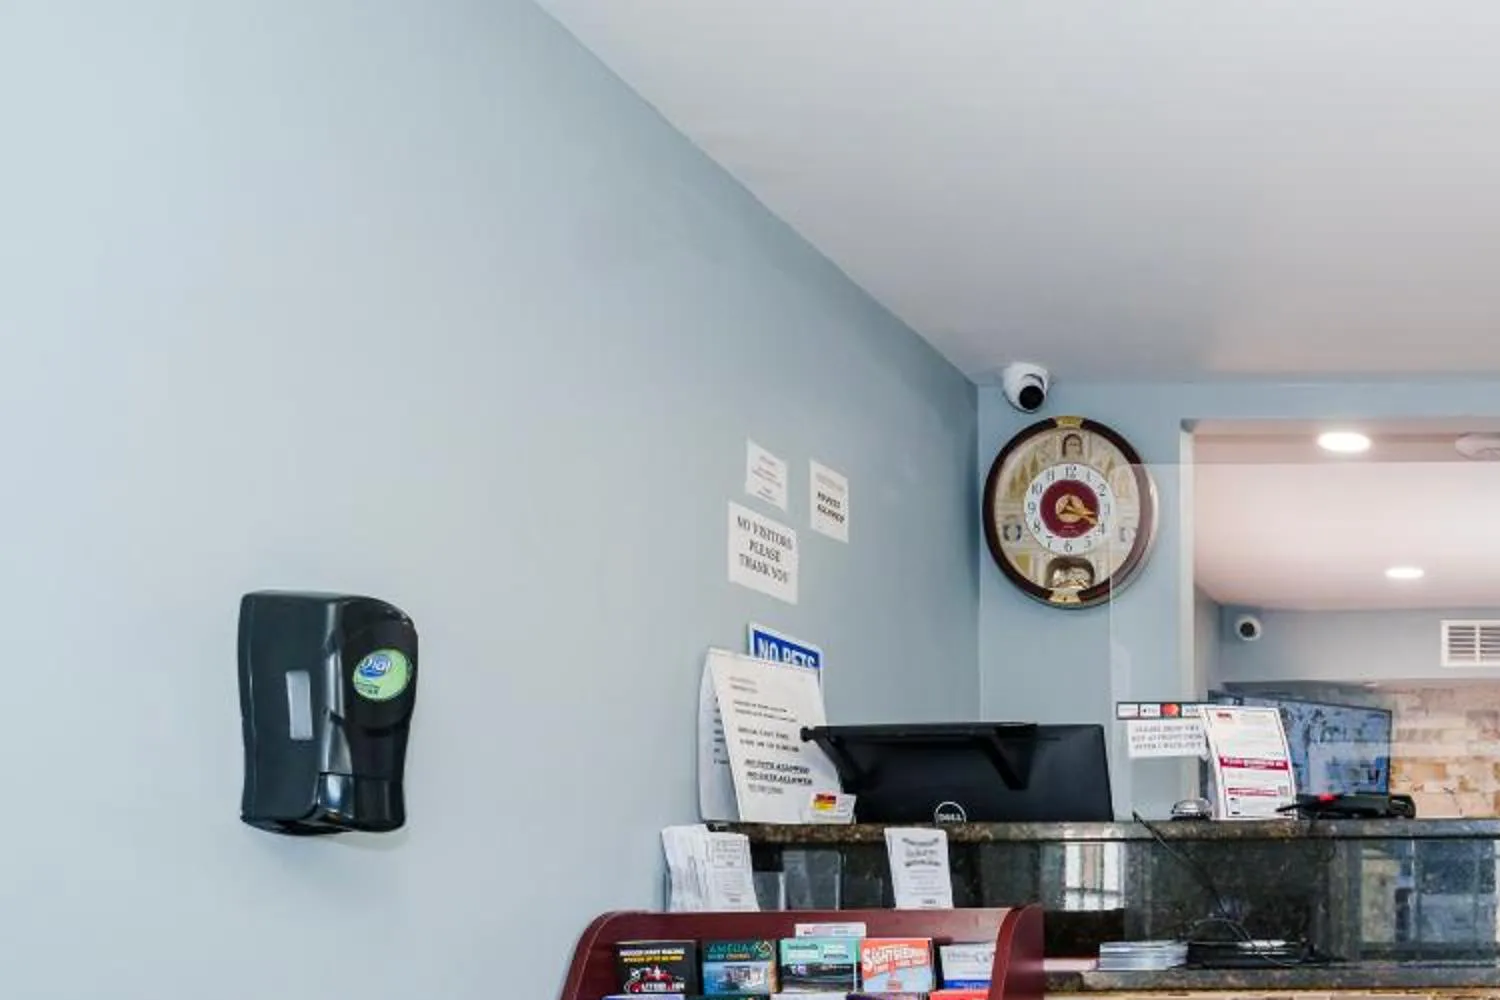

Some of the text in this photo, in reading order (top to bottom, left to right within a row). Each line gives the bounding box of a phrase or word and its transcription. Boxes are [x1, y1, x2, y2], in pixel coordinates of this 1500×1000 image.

[737, 515, 793, 551] NO VISITORS
[749, 539, 781, 563] PLEASE
[738, 553, 770, 576] THANK
[757, 637, 816, 669] NO PETS
[938, 813, 962, 822] DELL
